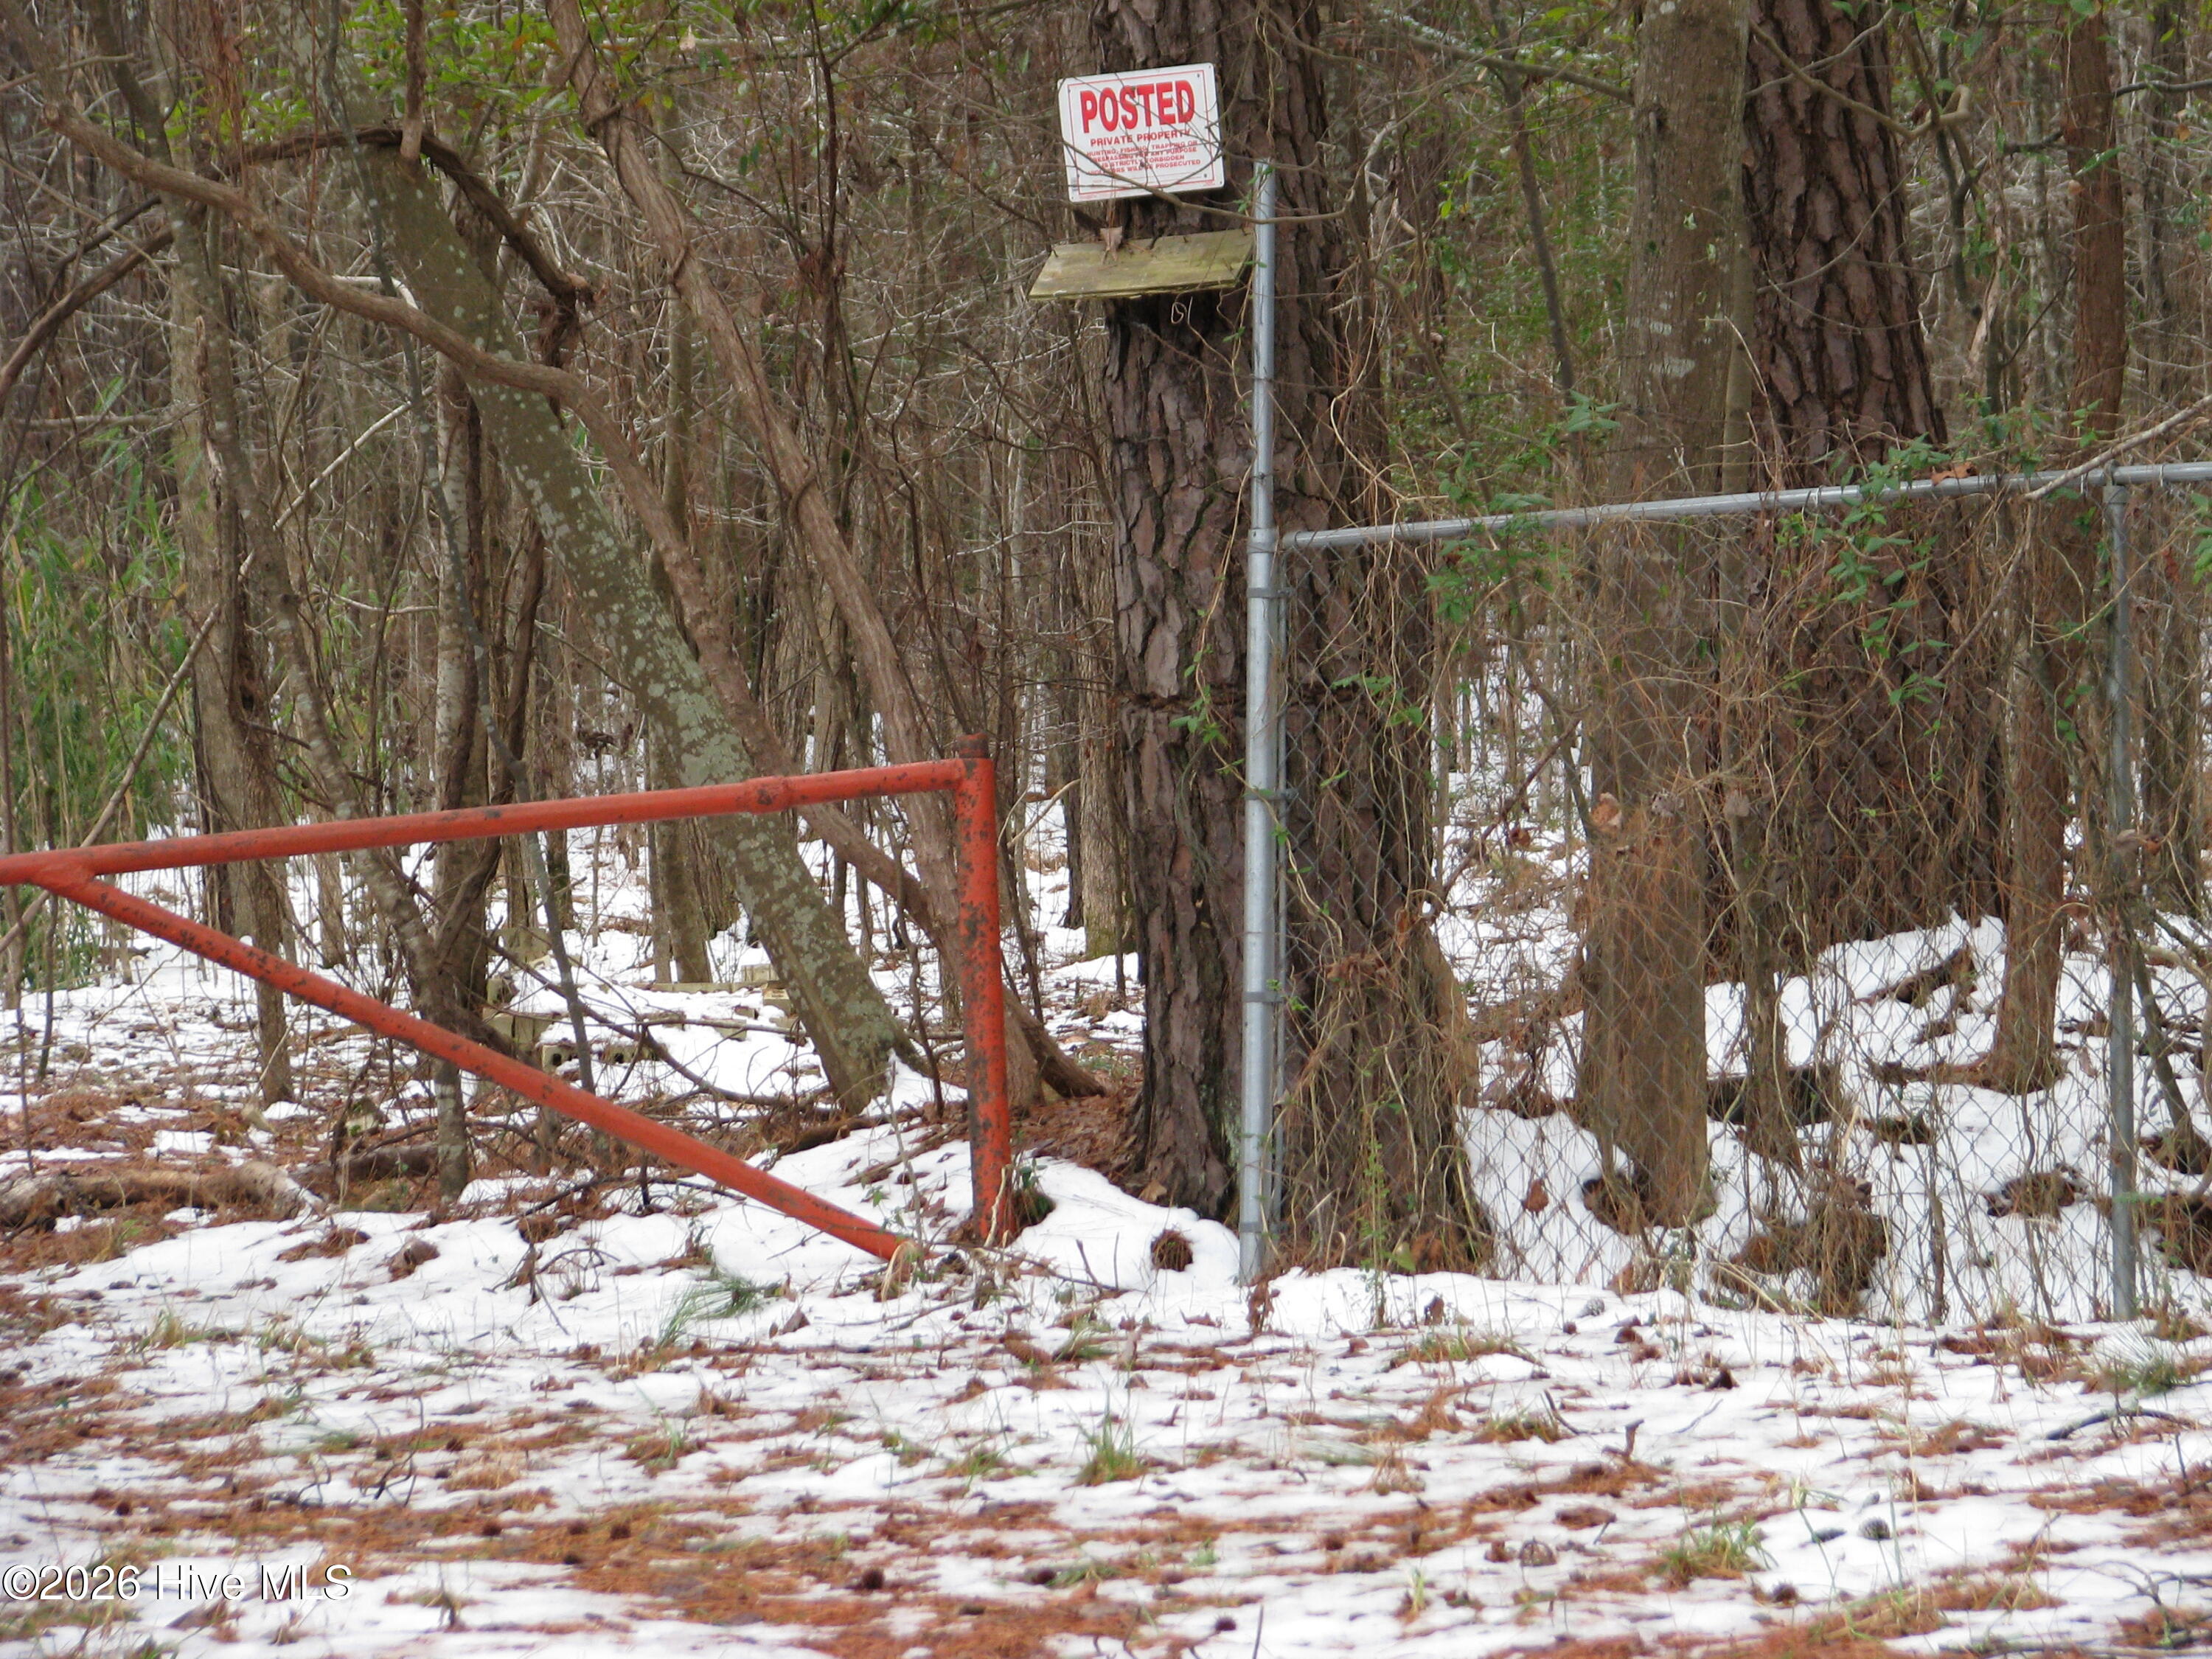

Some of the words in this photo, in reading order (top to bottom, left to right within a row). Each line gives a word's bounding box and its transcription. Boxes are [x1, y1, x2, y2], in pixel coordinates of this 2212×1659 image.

[1080, 80, 1194, 133] POSTED
[1091, 134, 1133, 147] PRIVATE
[1137, 128, 1191, 142] PROPERTY
[1166, 147, 1197, 155] PURPOSE
[1155, 159, 1200, 169] PROSECUTED
